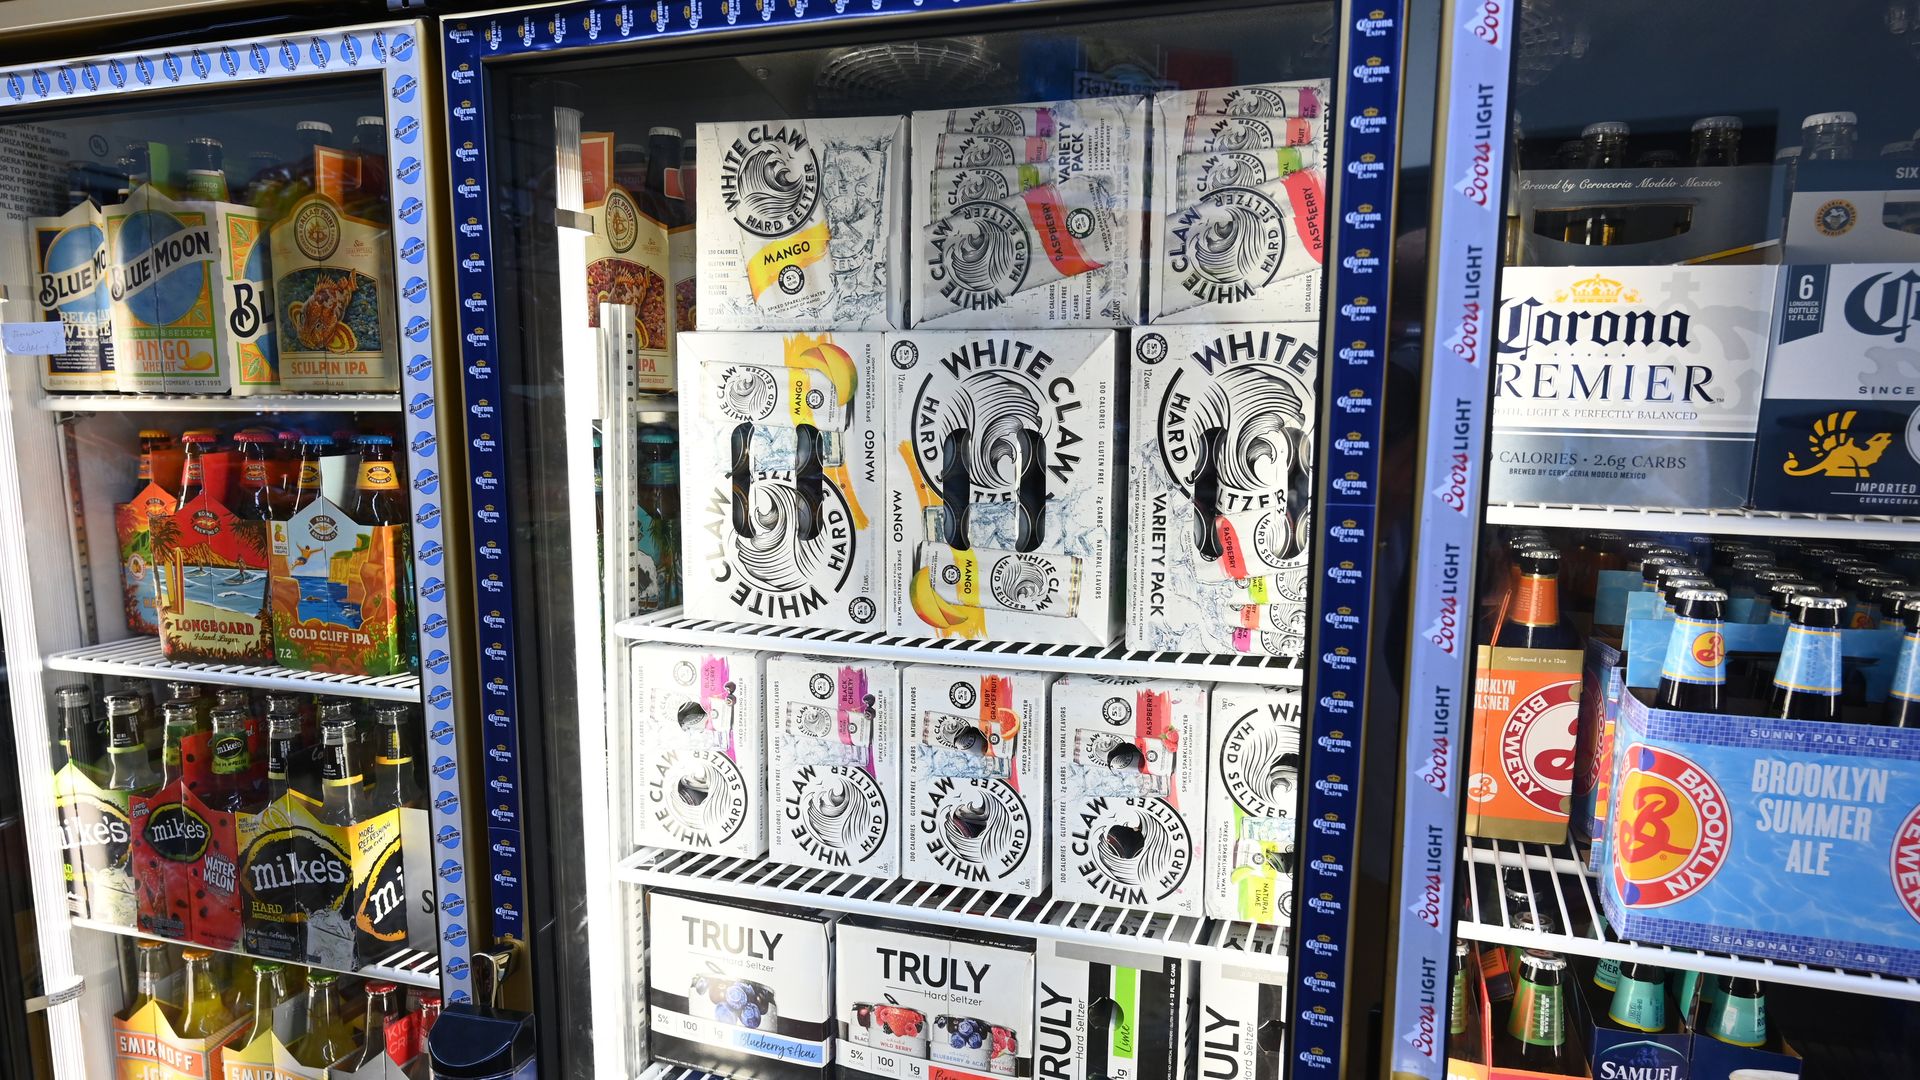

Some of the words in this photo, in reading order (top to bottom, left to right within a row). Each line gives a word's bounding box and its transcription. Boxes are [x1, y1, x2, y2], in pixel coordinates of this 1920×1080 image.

[1356, 19, 1393, 31] Corona
[392, 85, 406, 98] BLUE
[452, 70, 475, 80] Corona
[1476, 83, 1494, 139] LIGHT
[721, 138, 748, 212] WHITE
[748, 124, 807, 151] CLAW
[1059, 122, 1071, 185] VARIETY
[1071, 132, 1084, 173] PACK
[1464, 142, 1491, 206] Coors
[1520, 179, 1559, 191] Brewed
[1561, 180, 1575, 192] by
[1579, 178, 1632, 189] Cerveceria
[1635, 177, 1678, 189] Modelo
[1680, 176, 1723, 188] Mexico
[1895, 167, 1919, 179] SIX
[745, 214, 783, 232] HARD
[787, 163, 815, 225] SELTZER
[1215, 194, 1276, 224] SELTZER
[964, 207, 1019, 236] SELTZER
[1041, 202, 1064, 262] RASPBERRY
[1303, 187, 1323, 250] RASPBERRY
[763, 241, 811, 266] MANGO
[928, 217, 954, 281] CLAW
[1169, 206, 1201, 273] CLAW
[1260, 229, 1279, 273] HARD
[111, 258, 151, 302] BLUE
[1009, 241, 1025, 283] HARD
[39, 266, 92, 307] BLUE
[940, 282, 1006, 311] WHITE
[1183, 273, 1256, 304] WHITE
[1798, 274, 1815, 300] 6
[1497, 296, 1692, 361] Corona
[291, 361, 340, 375] SCULPIN
[345, 361, 368, 375] IPA
[1192, 331, 1319, 375] WHITE
[794, 380, 804, 416] MANGO
[1494, 363, 1716, 403] REMIER
[1858, 386, 1915, 395] SINCE
[919, 396, 941, 463] HARD
[940, 338, 1055, 380] WHITE
[1047, 376, 1084, 485] CLAW
[1166, 392, 1191, 464] HARD
[1526, 408, 1559, 417] LIGHT
[1562, 409, 1570, 417] &
[1574, 409, 1634, 420] PERFECTLY
[1637, 410, 1698, 421] BALANCED
[865, 429, 876, 483] MANGO
[1499, 451, 1578, 466] CALORIES
[1631, 455, 1687, 470] CARBS
[1855, 482, 1917, 494] IMPORTED
[1859, 497, 1919, 505] CERVECERIA
[704, 486, 732, 583] CLAW
[893, 490, 904, 543] MANGO
[1152, 493, 1167, 566] VARIETY
[827, 509, 849, 572] HARD
[1223, 527, 1236, 569] RASPBERRY
[964, 559, 972, 594] MANGO
[1443, 543, 1460, 594] LIGHT
[730, 581, 829, 620] WHITE
[1150, 571, 1165, 617] PACK
[175, 618, 254, 636] LONGBOARD
[194, 633, 216, 642] Island
[289, 628, 317, 640] GOLD
[320, 630, 349, 643] CLIFF
[352, 632, 371, 645] IPA
[1432, 596, 1457, 653] Coors
[279, 648, 292, 658] 7.2
[1320, 696, 1354, 708] Corona
[1329, 706, 1348, 714] Extra
[1474, 695, 1509, 711] ILSNER
[217, 740, 243, 754] mike's
[1227, 722, 1254, 764] HARD
[1505, 695, 1549, 797] BREWERY
[1750, 729, 1805, 741] SUNNY
[1814, 734, 1857, 746] PALE
[1867, 738, 1900, 748] ALE
[650, 750, 679, 803] CLAW
[694, 751, 740, 791] SELTZER
[831, 766, 880, 807] SELTZER
[1751, 759, 1888, 804] BROOKLYN
[786, 765, 816, 820] CLAW
[921, 777, 955, 834] CLAW
[971, 778, 1023, 821] SELTZER
[1229, 772, 1288, 819] SELTZER
[152, 817, 206, 844] mike's
[359, 824, 375, 839] MORE
[655, 808, 712, 848] WHITE
[722, 798, 742, 833] HARD
[861, 815, 882, 852] HARD
[1072, 797, 1109, 857] CLAW
[1127, 798, 1183, 841] SELTZER
[1667, 768, 1724, 896] BROOKLYN
[1756, 798, 1872, 842] SUMMER
[792, 825, 852, 866] WHITE
[926, 839, 990, 882] WHITE
[1001, 828, 1025, 868] HARD
[1785, 840, 1833, 876] ALE
[203, 869, 235, 893] MELON
[204, 857, 237, 878] WATER
[251, 852, 345, 892] mike's
[1078, 859, 1148, 905] WHITE
[1160, 848, 1185, 889] HARD
[252, 902, 282, 914] HARD
[252, 913, 285, 923] lemonade
[1261, 883, 1269, 914] NATURAL
[681, 915, 783, 961] TRULY
[1712, 935, 1798, 953] SEASONAL
[1855, 953, 1889, 965] ABV
[746, 961, 774, 973] Seltzer
[876, 948, 991, 994] TRULY
[924, 990, 947, 1002] Hard
[950, 994, 983, 1007] Seltzer
[1075, 998, 1084, 1033] Seltzer
[120, 1036, 193, 1071] SMIRNOFF
[850, 1049, 864, 1061] 5%
[1076, 1036, 1084, 1060] Hard
[1115, 1024, 1130, 1053] Lime
[877, 1055, 894, 1068] 100
[910, 1063, 920, 1075] 1g
[1600, 1061, 1684, 1080] SAMUEL
